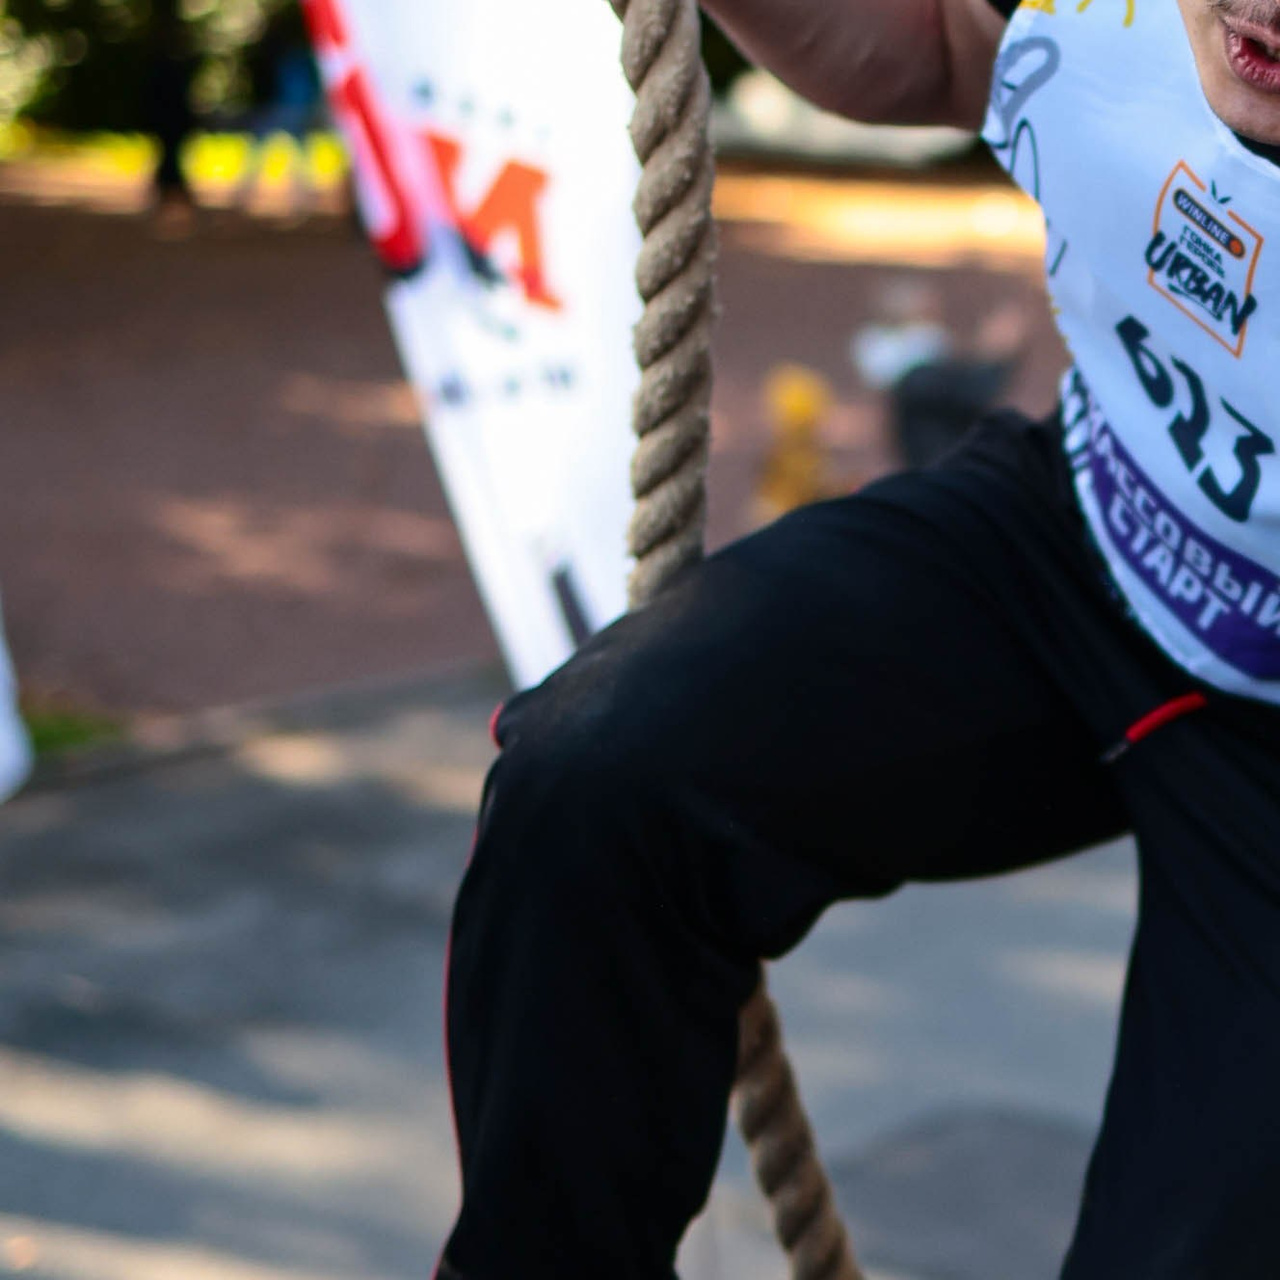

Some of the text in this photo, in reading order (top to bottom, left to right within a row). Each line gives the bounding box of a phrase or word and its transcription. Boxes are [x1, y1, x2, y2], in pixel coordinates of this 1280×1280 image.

[1177, 192, 1231, 246] WINLINE
[1144, 230, 1258, 336] URBAN
[1114, 313, 1275, 523] 623
[1109, 486, 1231, 631] СТАРТ
